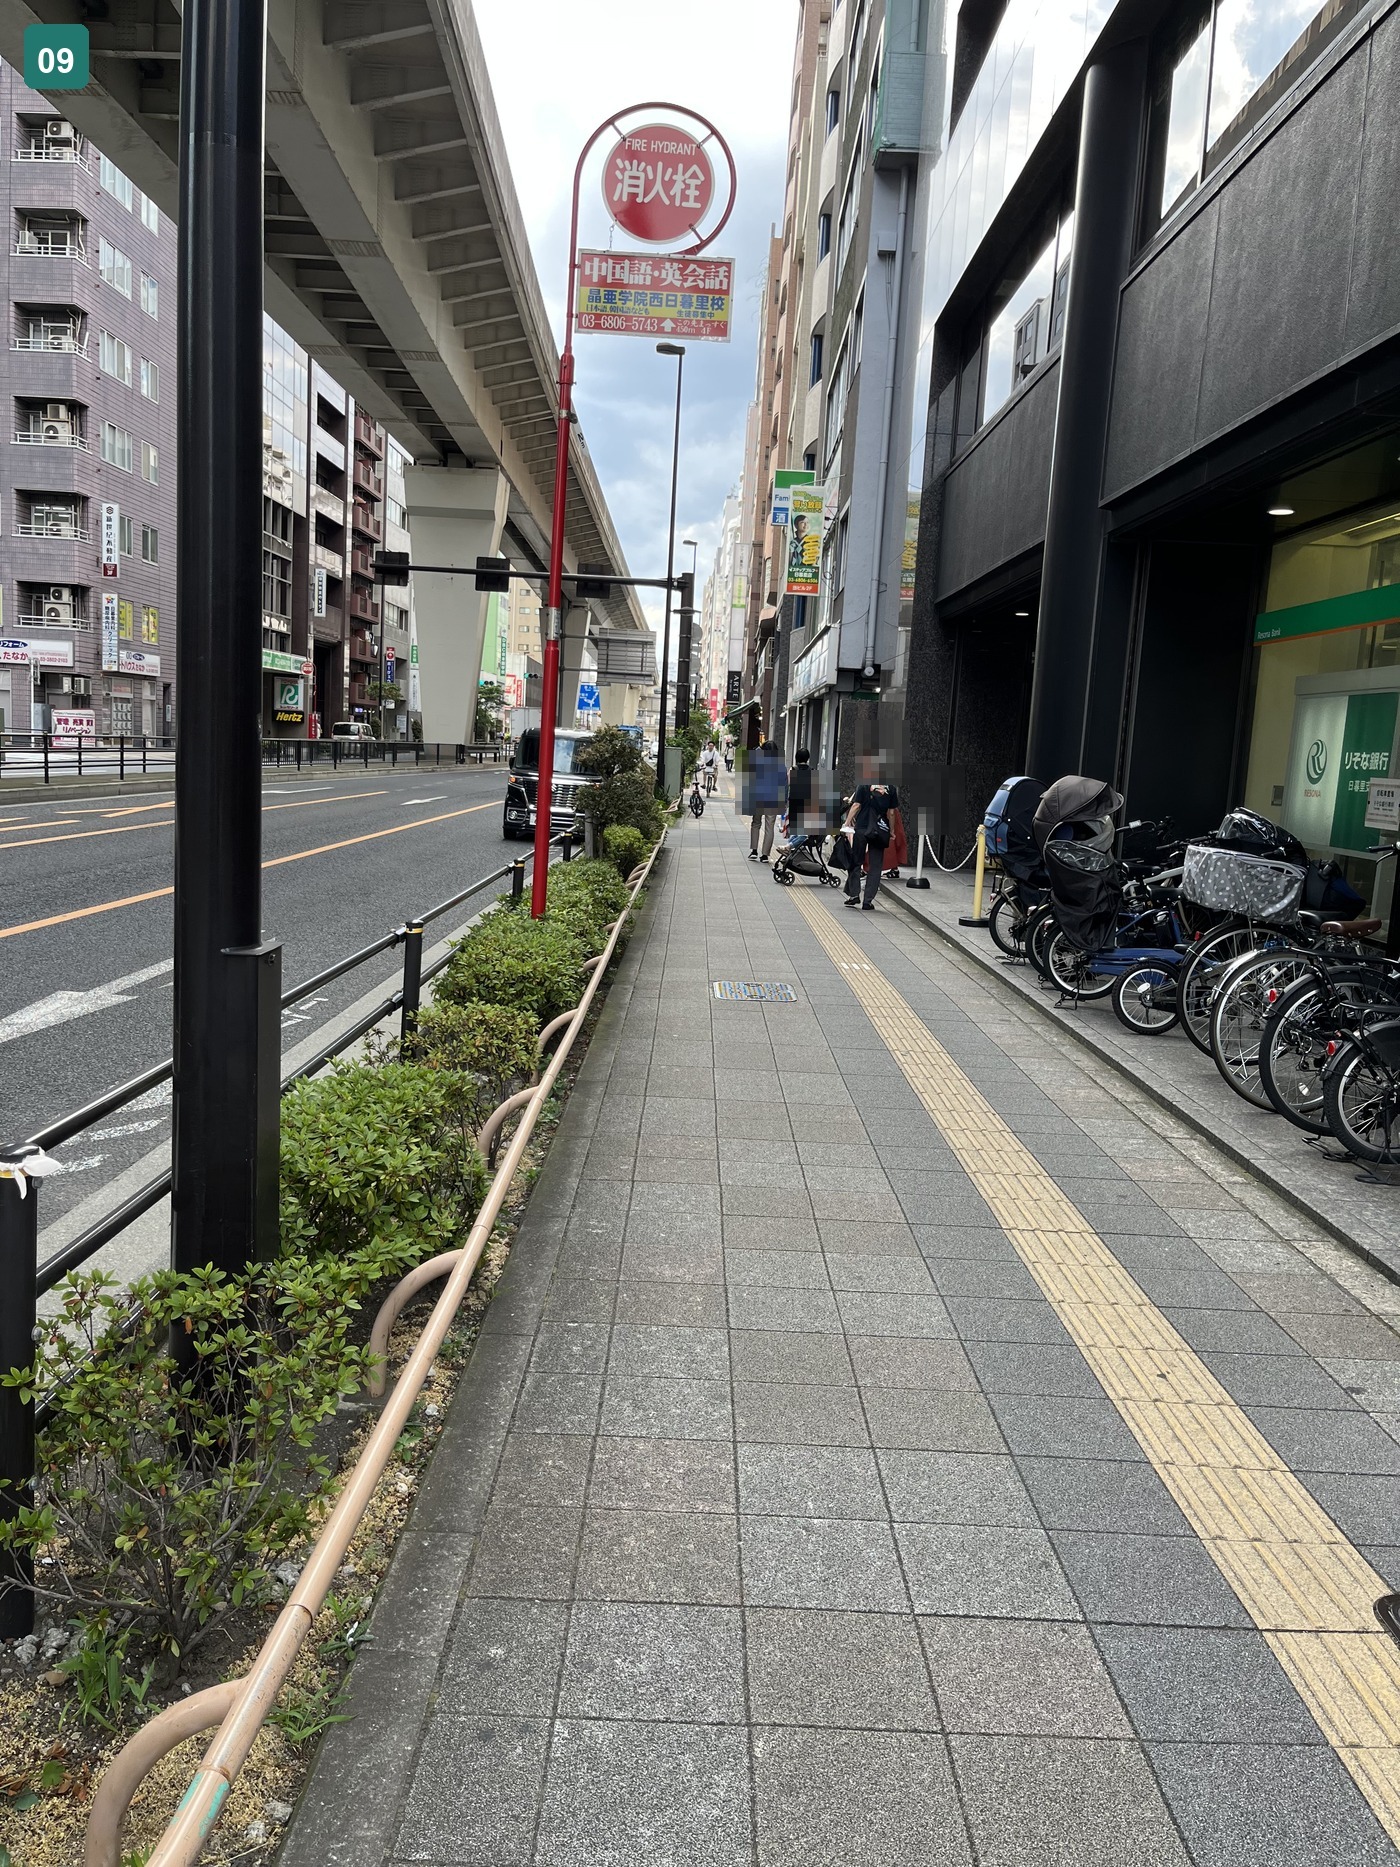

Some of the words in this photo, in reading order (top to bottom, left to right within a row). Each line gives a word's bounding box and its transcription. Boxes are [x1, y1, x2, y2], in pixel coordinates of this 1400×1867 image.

[625, 137, 648, 152] FIRE
[650, 140, 697, 156] HYDRANT
[613, 158, 705, 209] 消火栓
[584, 257, 729, 291] 中国語・英会話
[587, 288, 726, 312] 晶亜学院西日暮里校
[582, 314, 658, 332] 03-6806-5743
[676, 310, 715, 319] 生徒募集中
[775, 512, 786, 523] 酒
[275, 712, 303, 722] Hertz
[1344, 751, 1390, 771] りそな銀行
